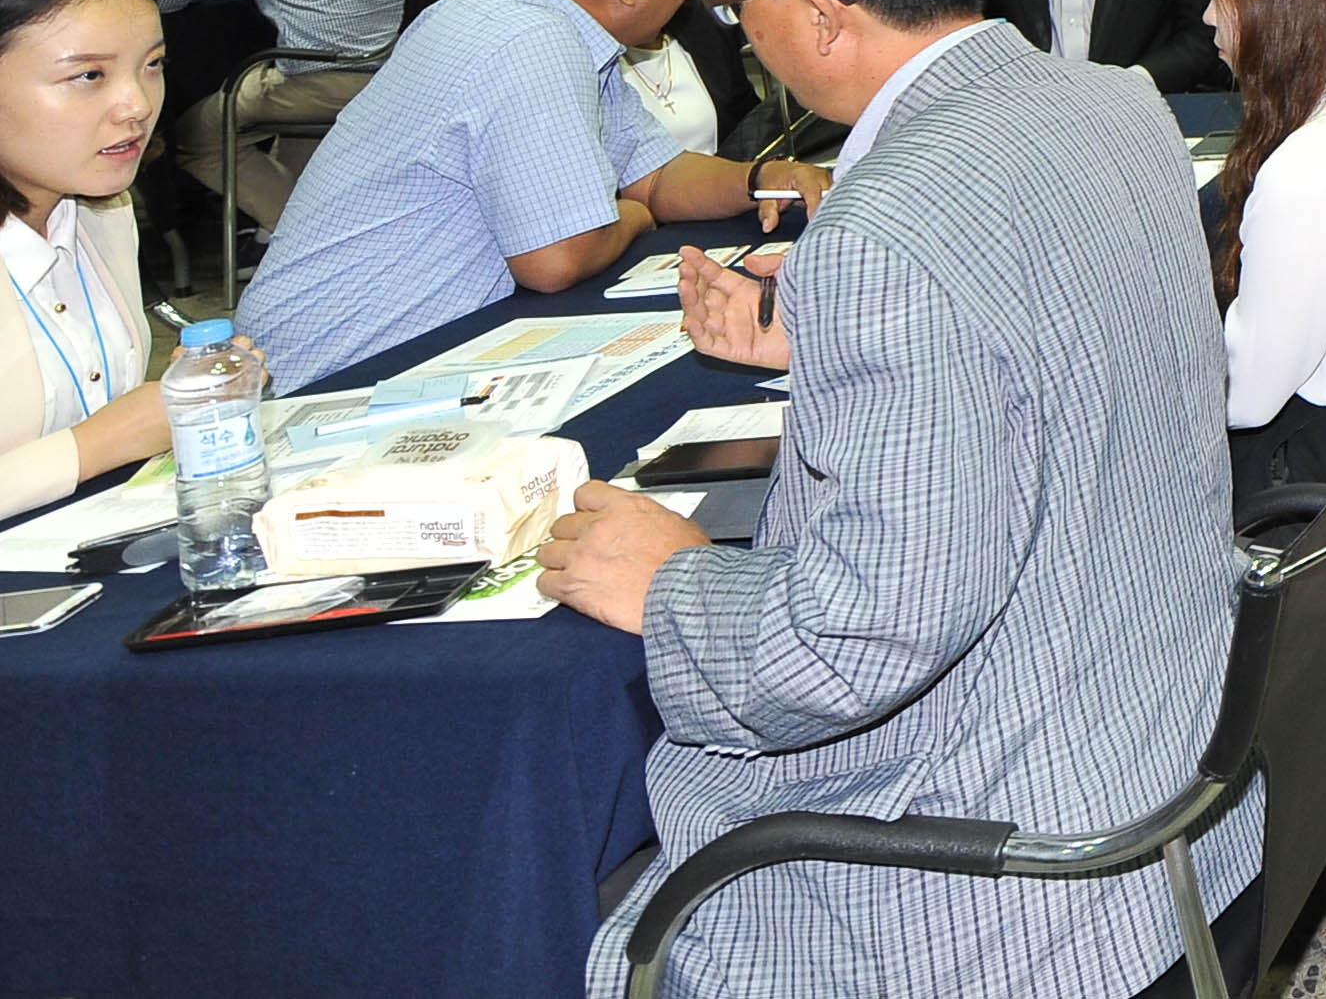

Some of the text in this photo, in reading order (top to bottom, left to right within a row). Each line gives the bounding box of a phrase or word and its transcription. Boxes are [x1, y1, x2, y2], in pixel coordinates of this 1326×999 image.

[395, 431, 470, 444] organic
[382, 442, 460, 458] natural
[419, 519, 464, 531] natural
[420, 532, 465, 543] organic
